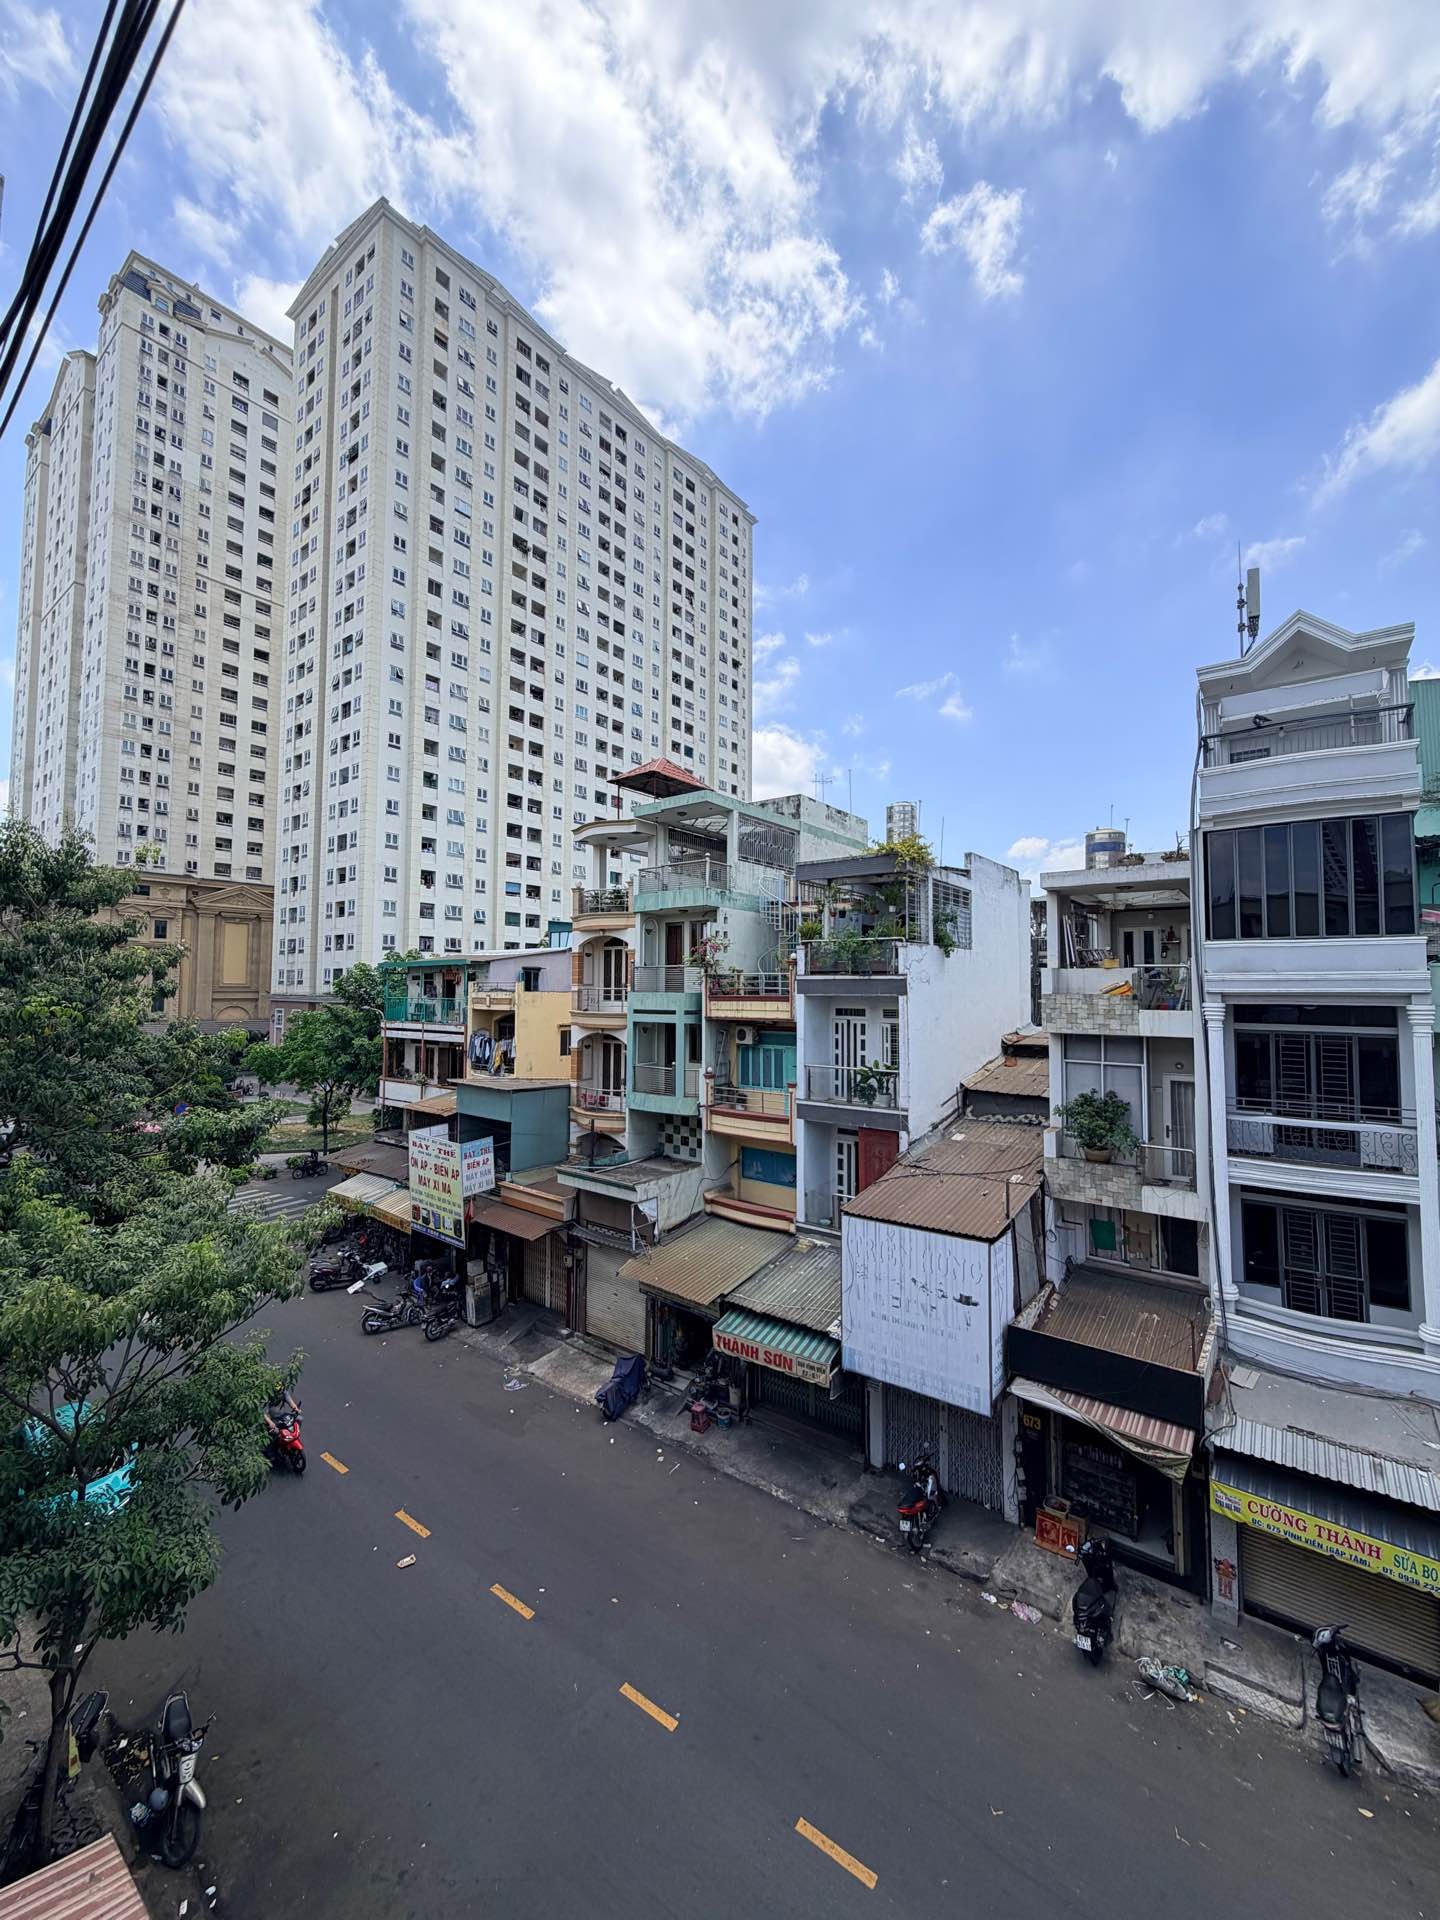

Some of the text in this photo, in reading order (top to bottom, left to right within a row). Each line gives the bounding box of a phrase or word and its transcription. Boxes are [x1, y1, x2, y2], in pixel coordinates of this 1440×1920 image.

[763, 1349, 794, 1372] SƠN
[1023, 1414, 1041, 1431] 673
[1247, 1499, 1308, 1533] CƯỜNG
[1314, 1524, 1382, 1561] THÀNH
[1393, 1552, 1418, 1576] SỬA
[1267, 1524, 1281, 1534] 675
